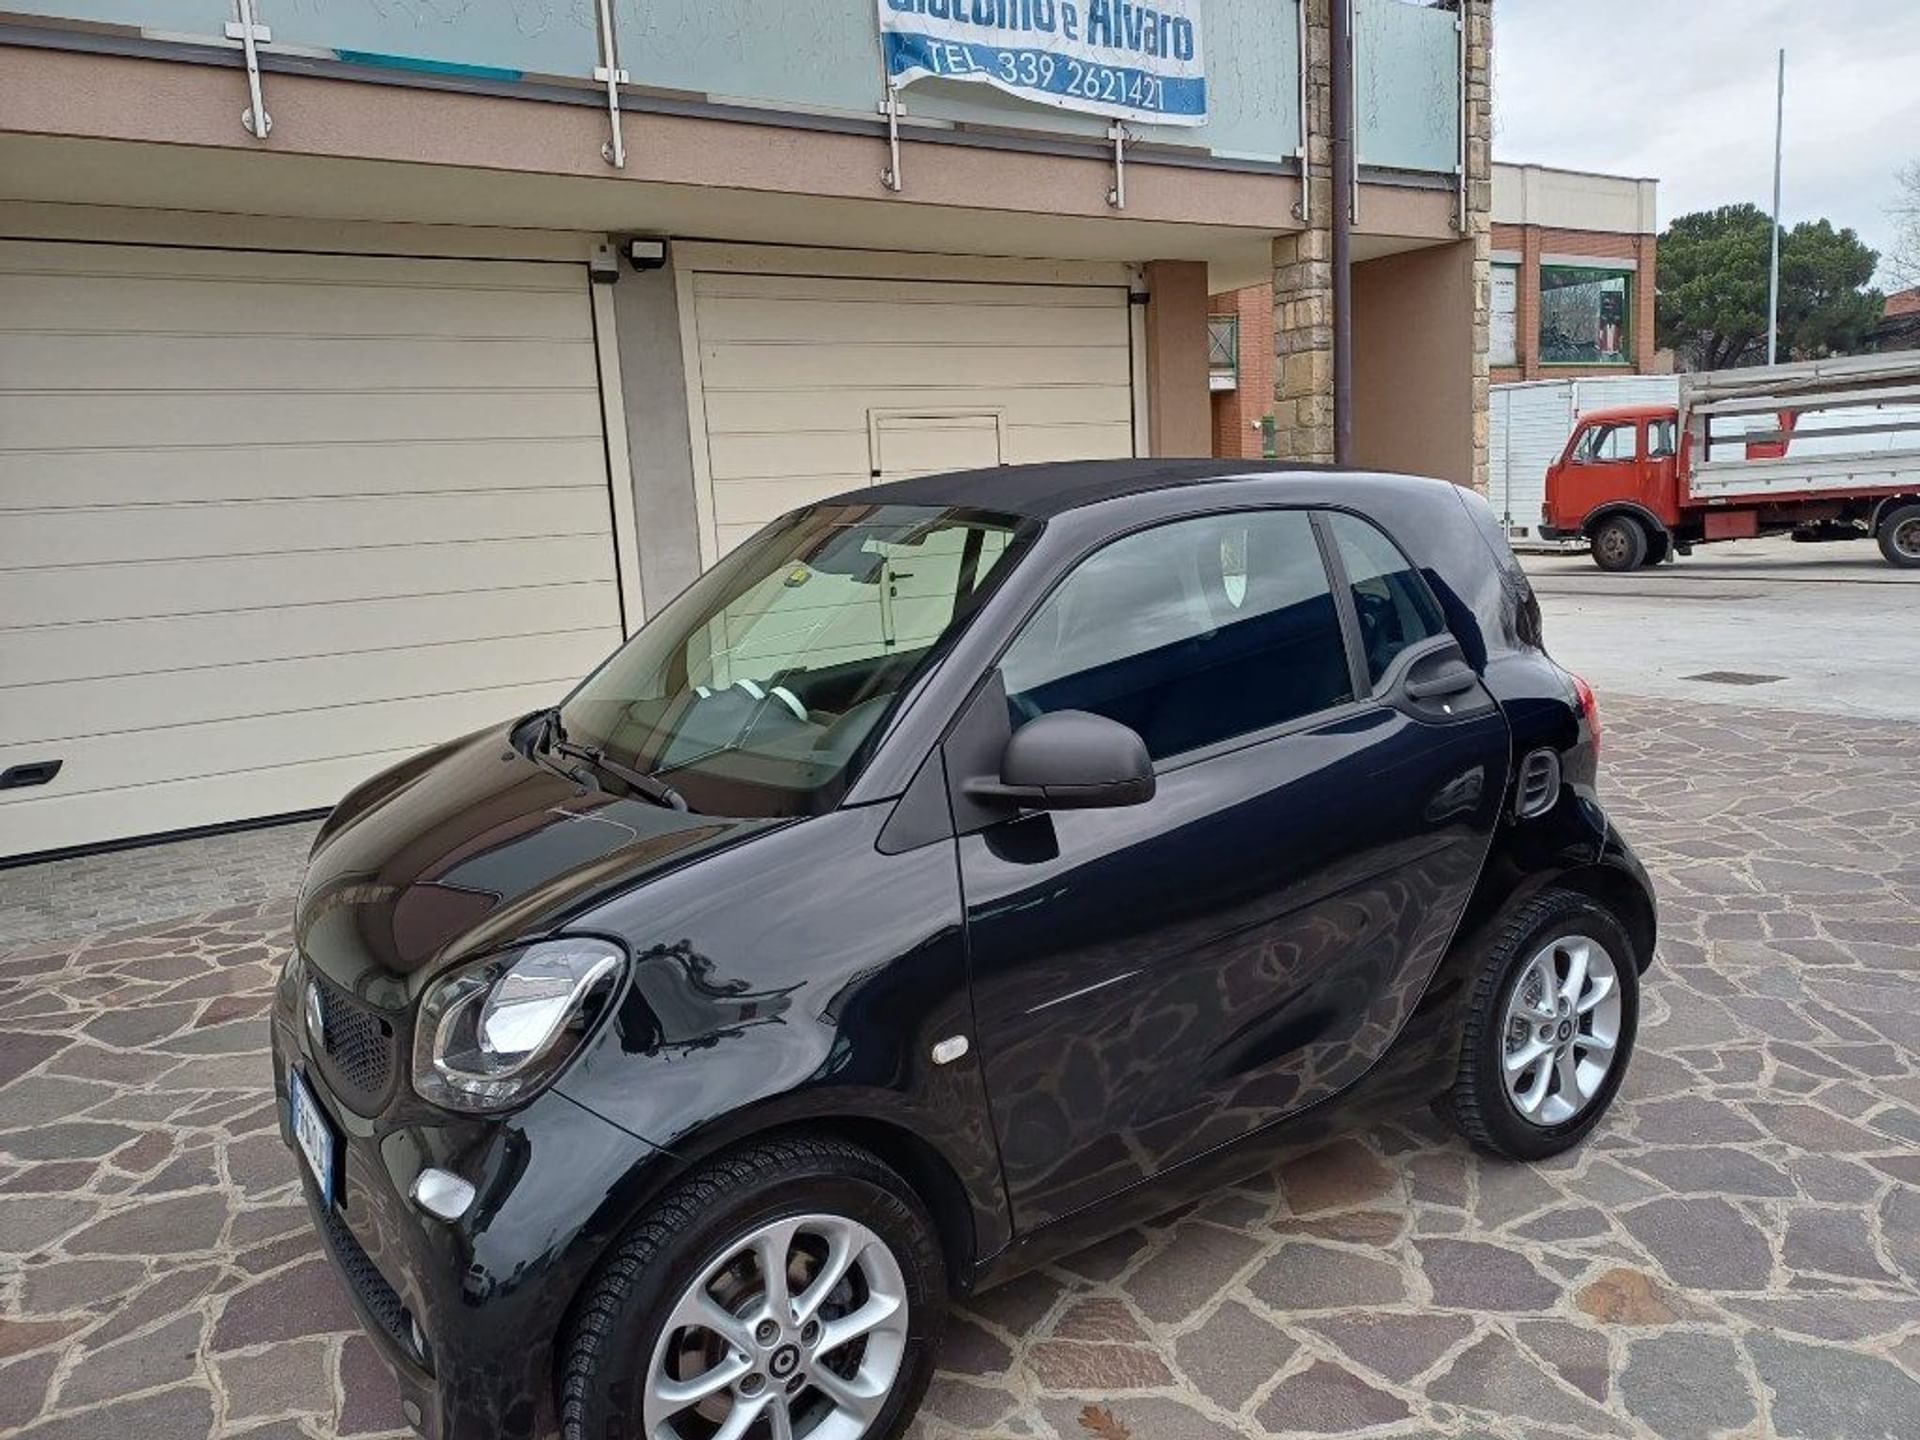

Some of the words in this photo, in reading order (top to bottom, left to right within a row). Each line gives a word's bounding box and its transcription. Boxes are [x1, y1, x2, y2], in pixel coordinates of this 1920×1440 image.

[886, 0, 1056, 33] como
[1061, 2, 1079, 41] e
[1087, 0, 1194, 61] Alvaro
[998, 52, 1055, 88] 339
[1066, 61, 1164, 110] 2621421
